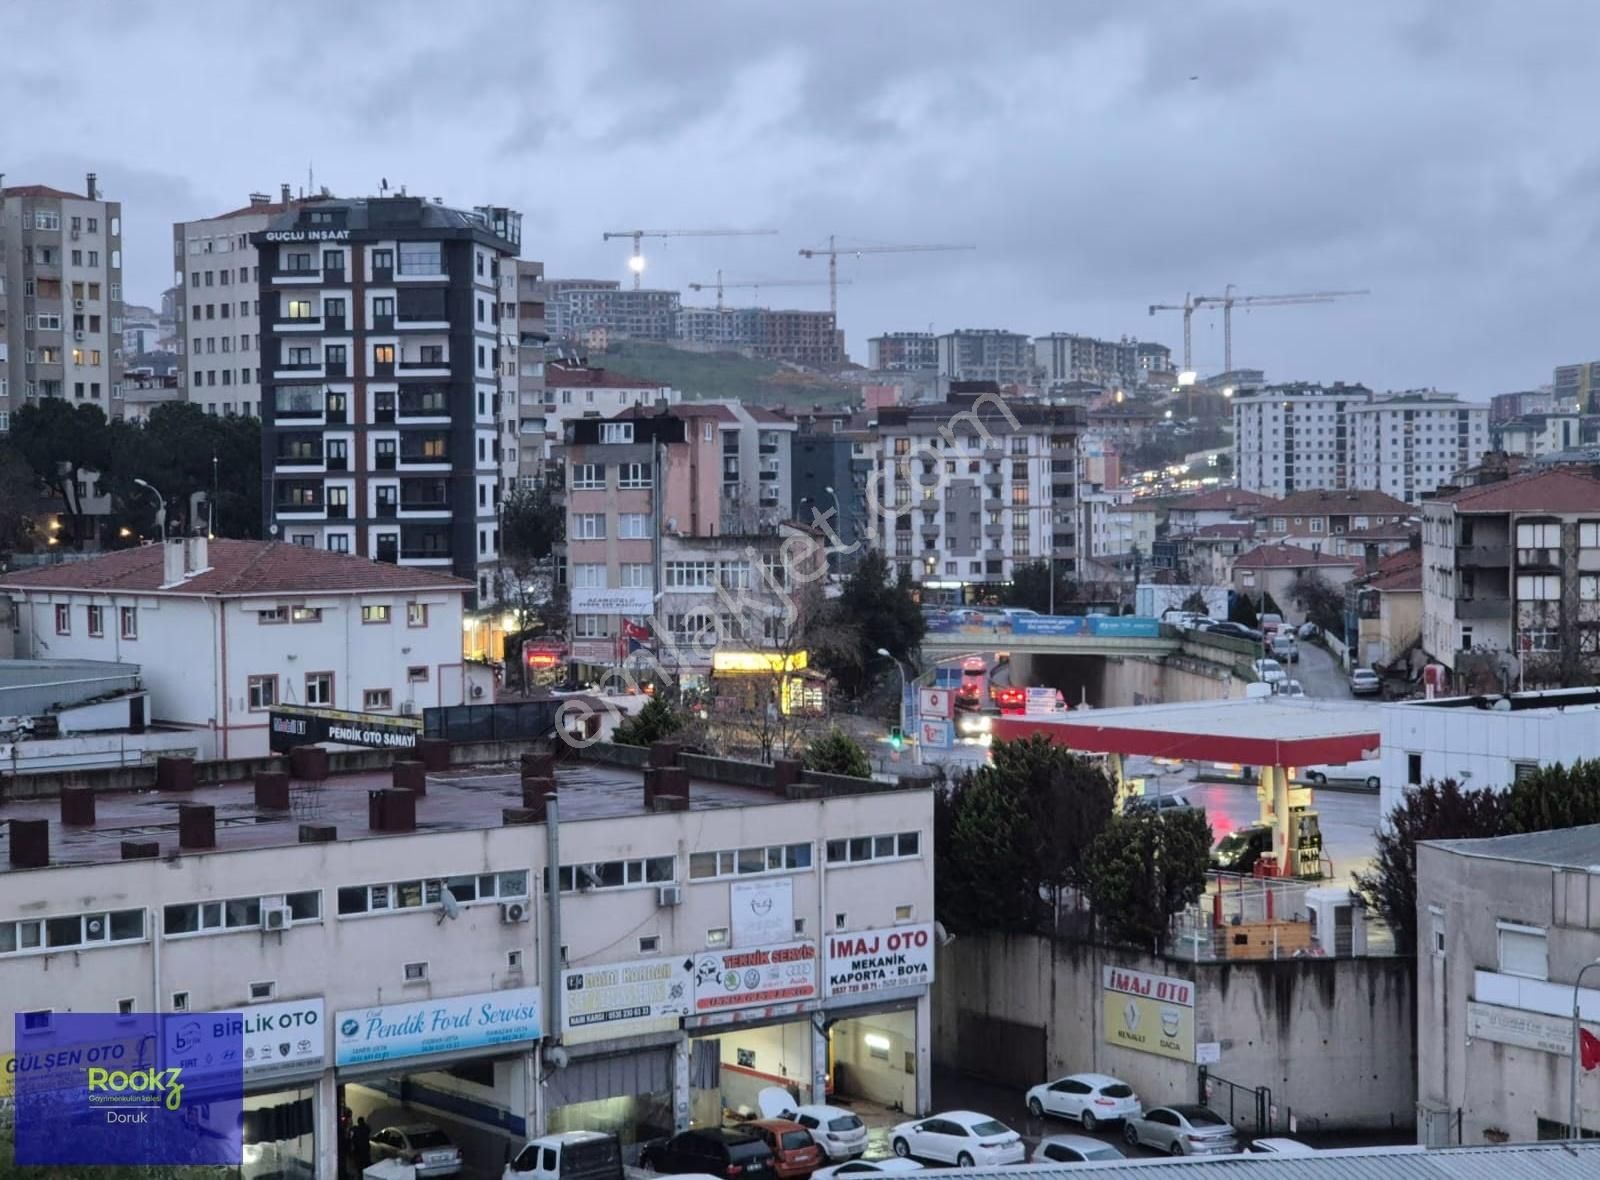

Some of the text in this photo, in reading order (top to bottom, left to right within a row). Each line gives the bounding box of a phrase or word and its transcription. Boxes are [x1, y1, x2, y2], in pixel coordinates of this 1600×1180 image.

[329, 726, 416, 747] PENDİK OTO SANAYİ
[722, 944, 815, 969] TEKNİK SERVİS
[830, 930, 928, 959] İMAJ OTO
[852, 952, 906, 971] MEKANİK
[830, 969, 886, 986] KAPORTA
[897, 963, 928, 976] BOYA
[1110, 969, 1189, 1003] İMAJ OTO
[213, 1010, 318, 1038] BİRLİK OTO
[366, 1000, 537, 1040] Pendik Ford Servisi
[87, 1044, 125, 1063] OTO
[180, 1057, 198, 1068] FIAT
